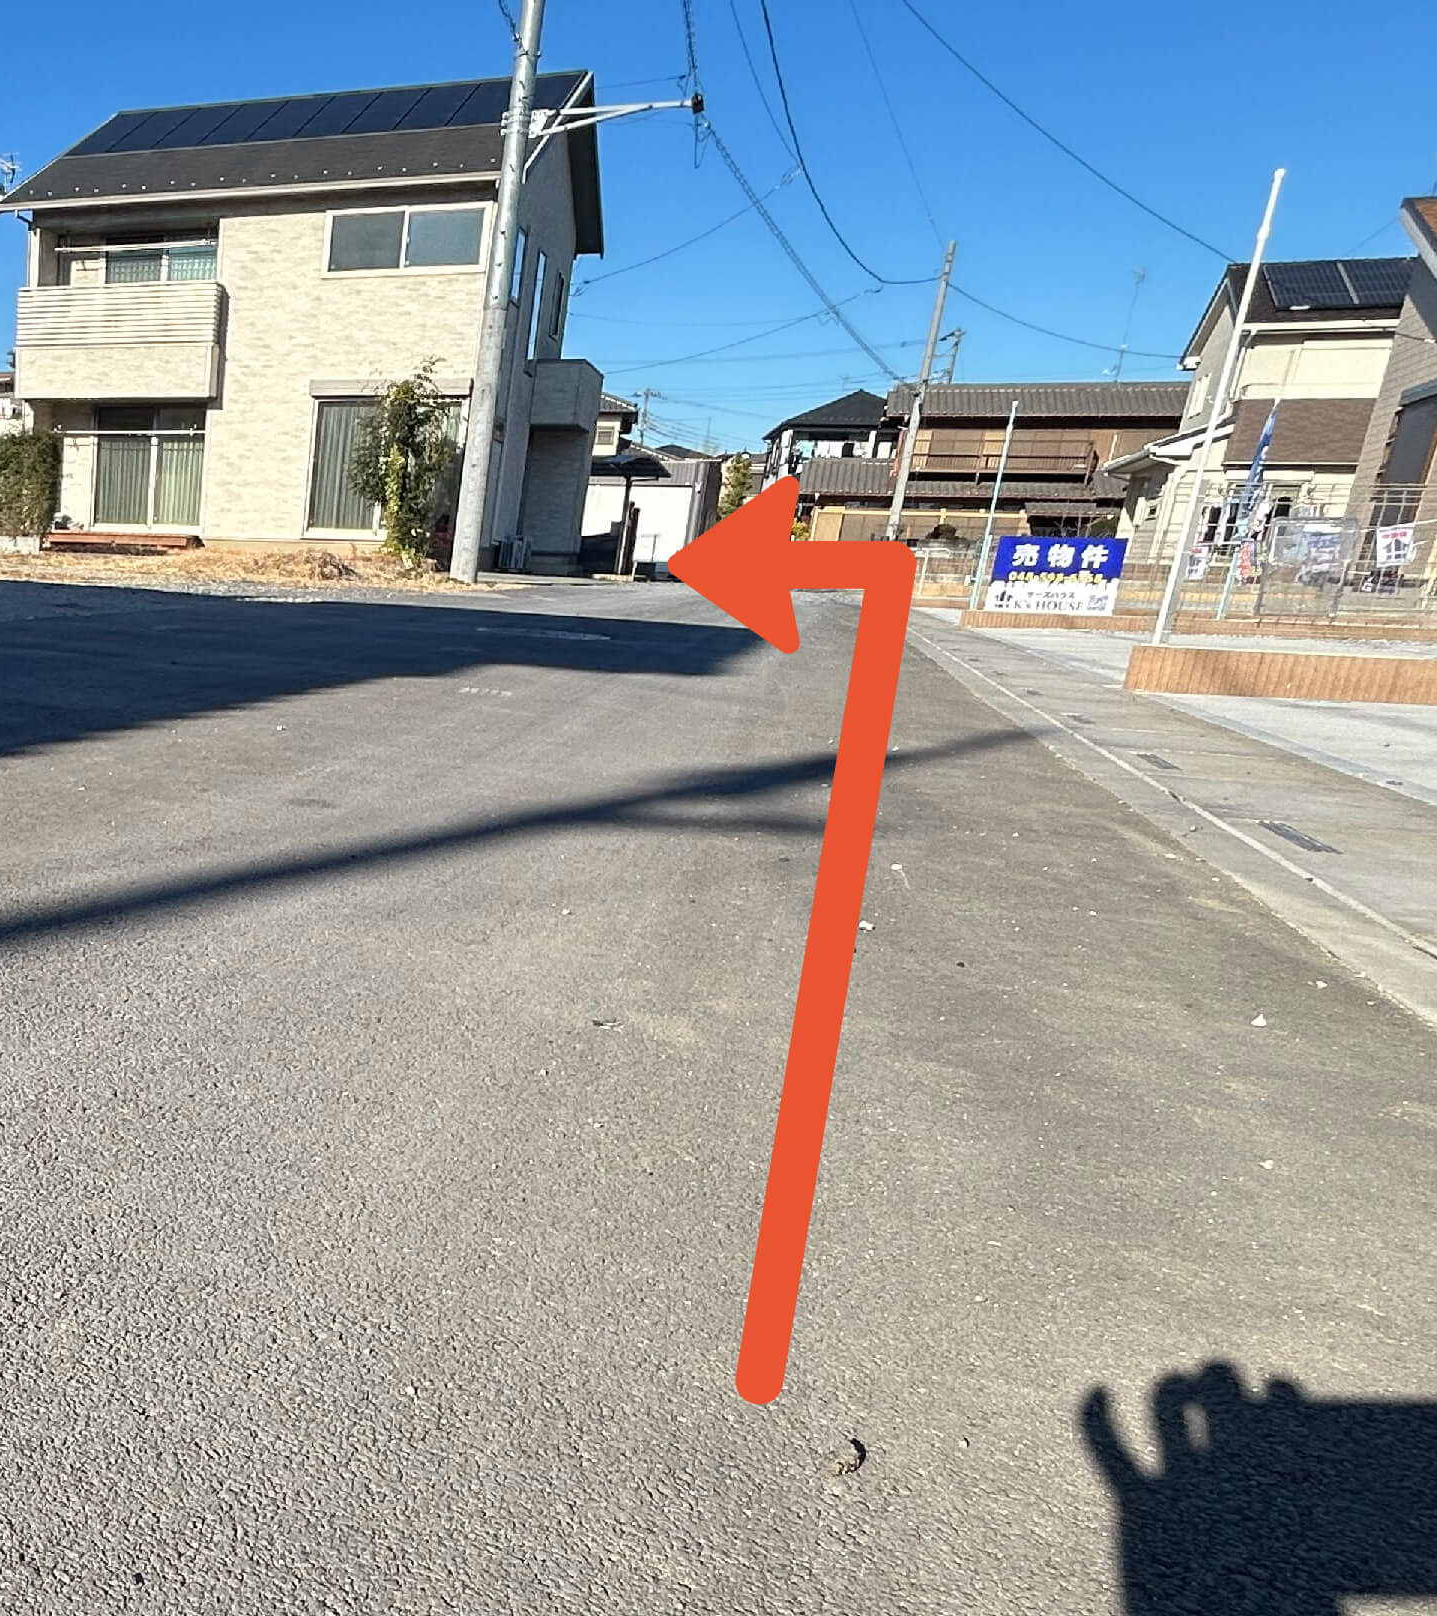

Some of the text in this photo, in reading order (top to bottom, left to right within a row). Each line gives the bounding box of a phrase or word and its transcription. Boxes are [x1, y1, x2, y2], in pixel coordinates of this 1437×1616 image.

[1012, 544, 1109, 568] 売物件
[1035, 601, 1084, 611] HOUSE
